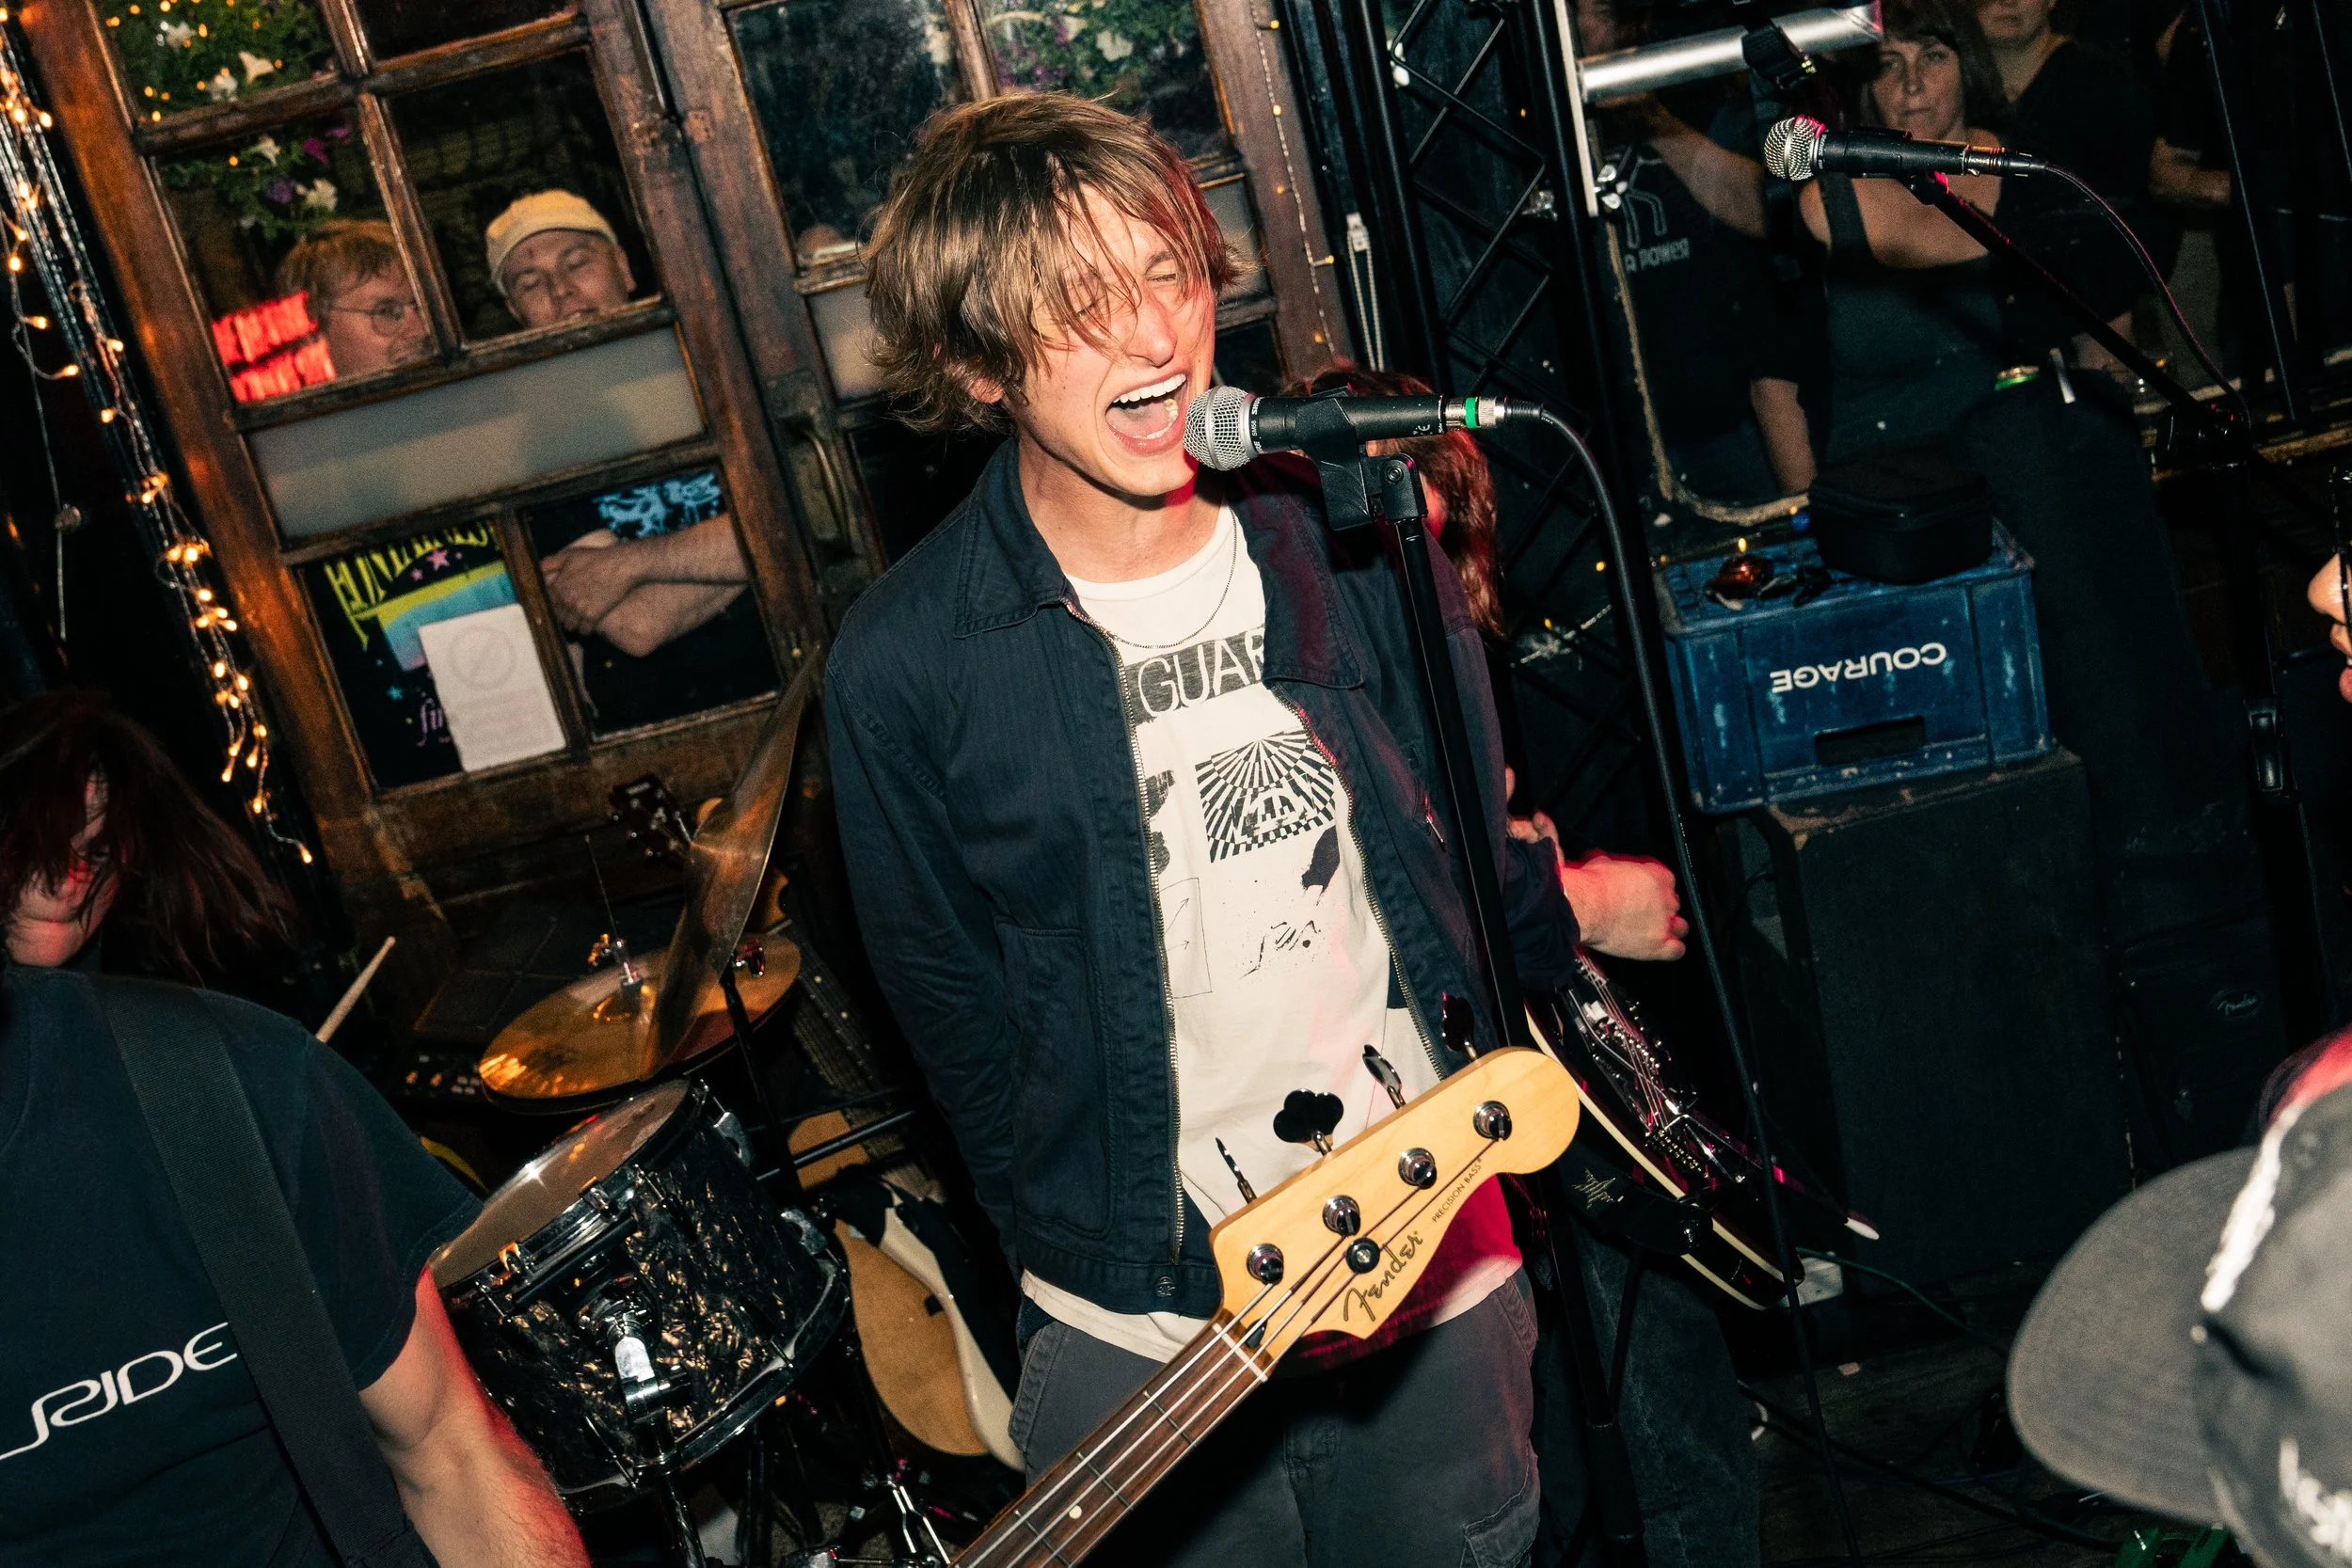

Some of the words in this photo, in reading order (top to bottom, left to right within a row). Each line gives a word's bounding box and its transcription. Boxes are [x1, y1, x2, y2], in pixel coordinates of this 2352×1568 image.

[1770, 641, 1947, 694] COURAGE
[1431, 1181, 1466, 1224] PRECISION
[1343, 1230, 1424, 1323] Fender
[0, 1321, 238, 1459] RIDE
